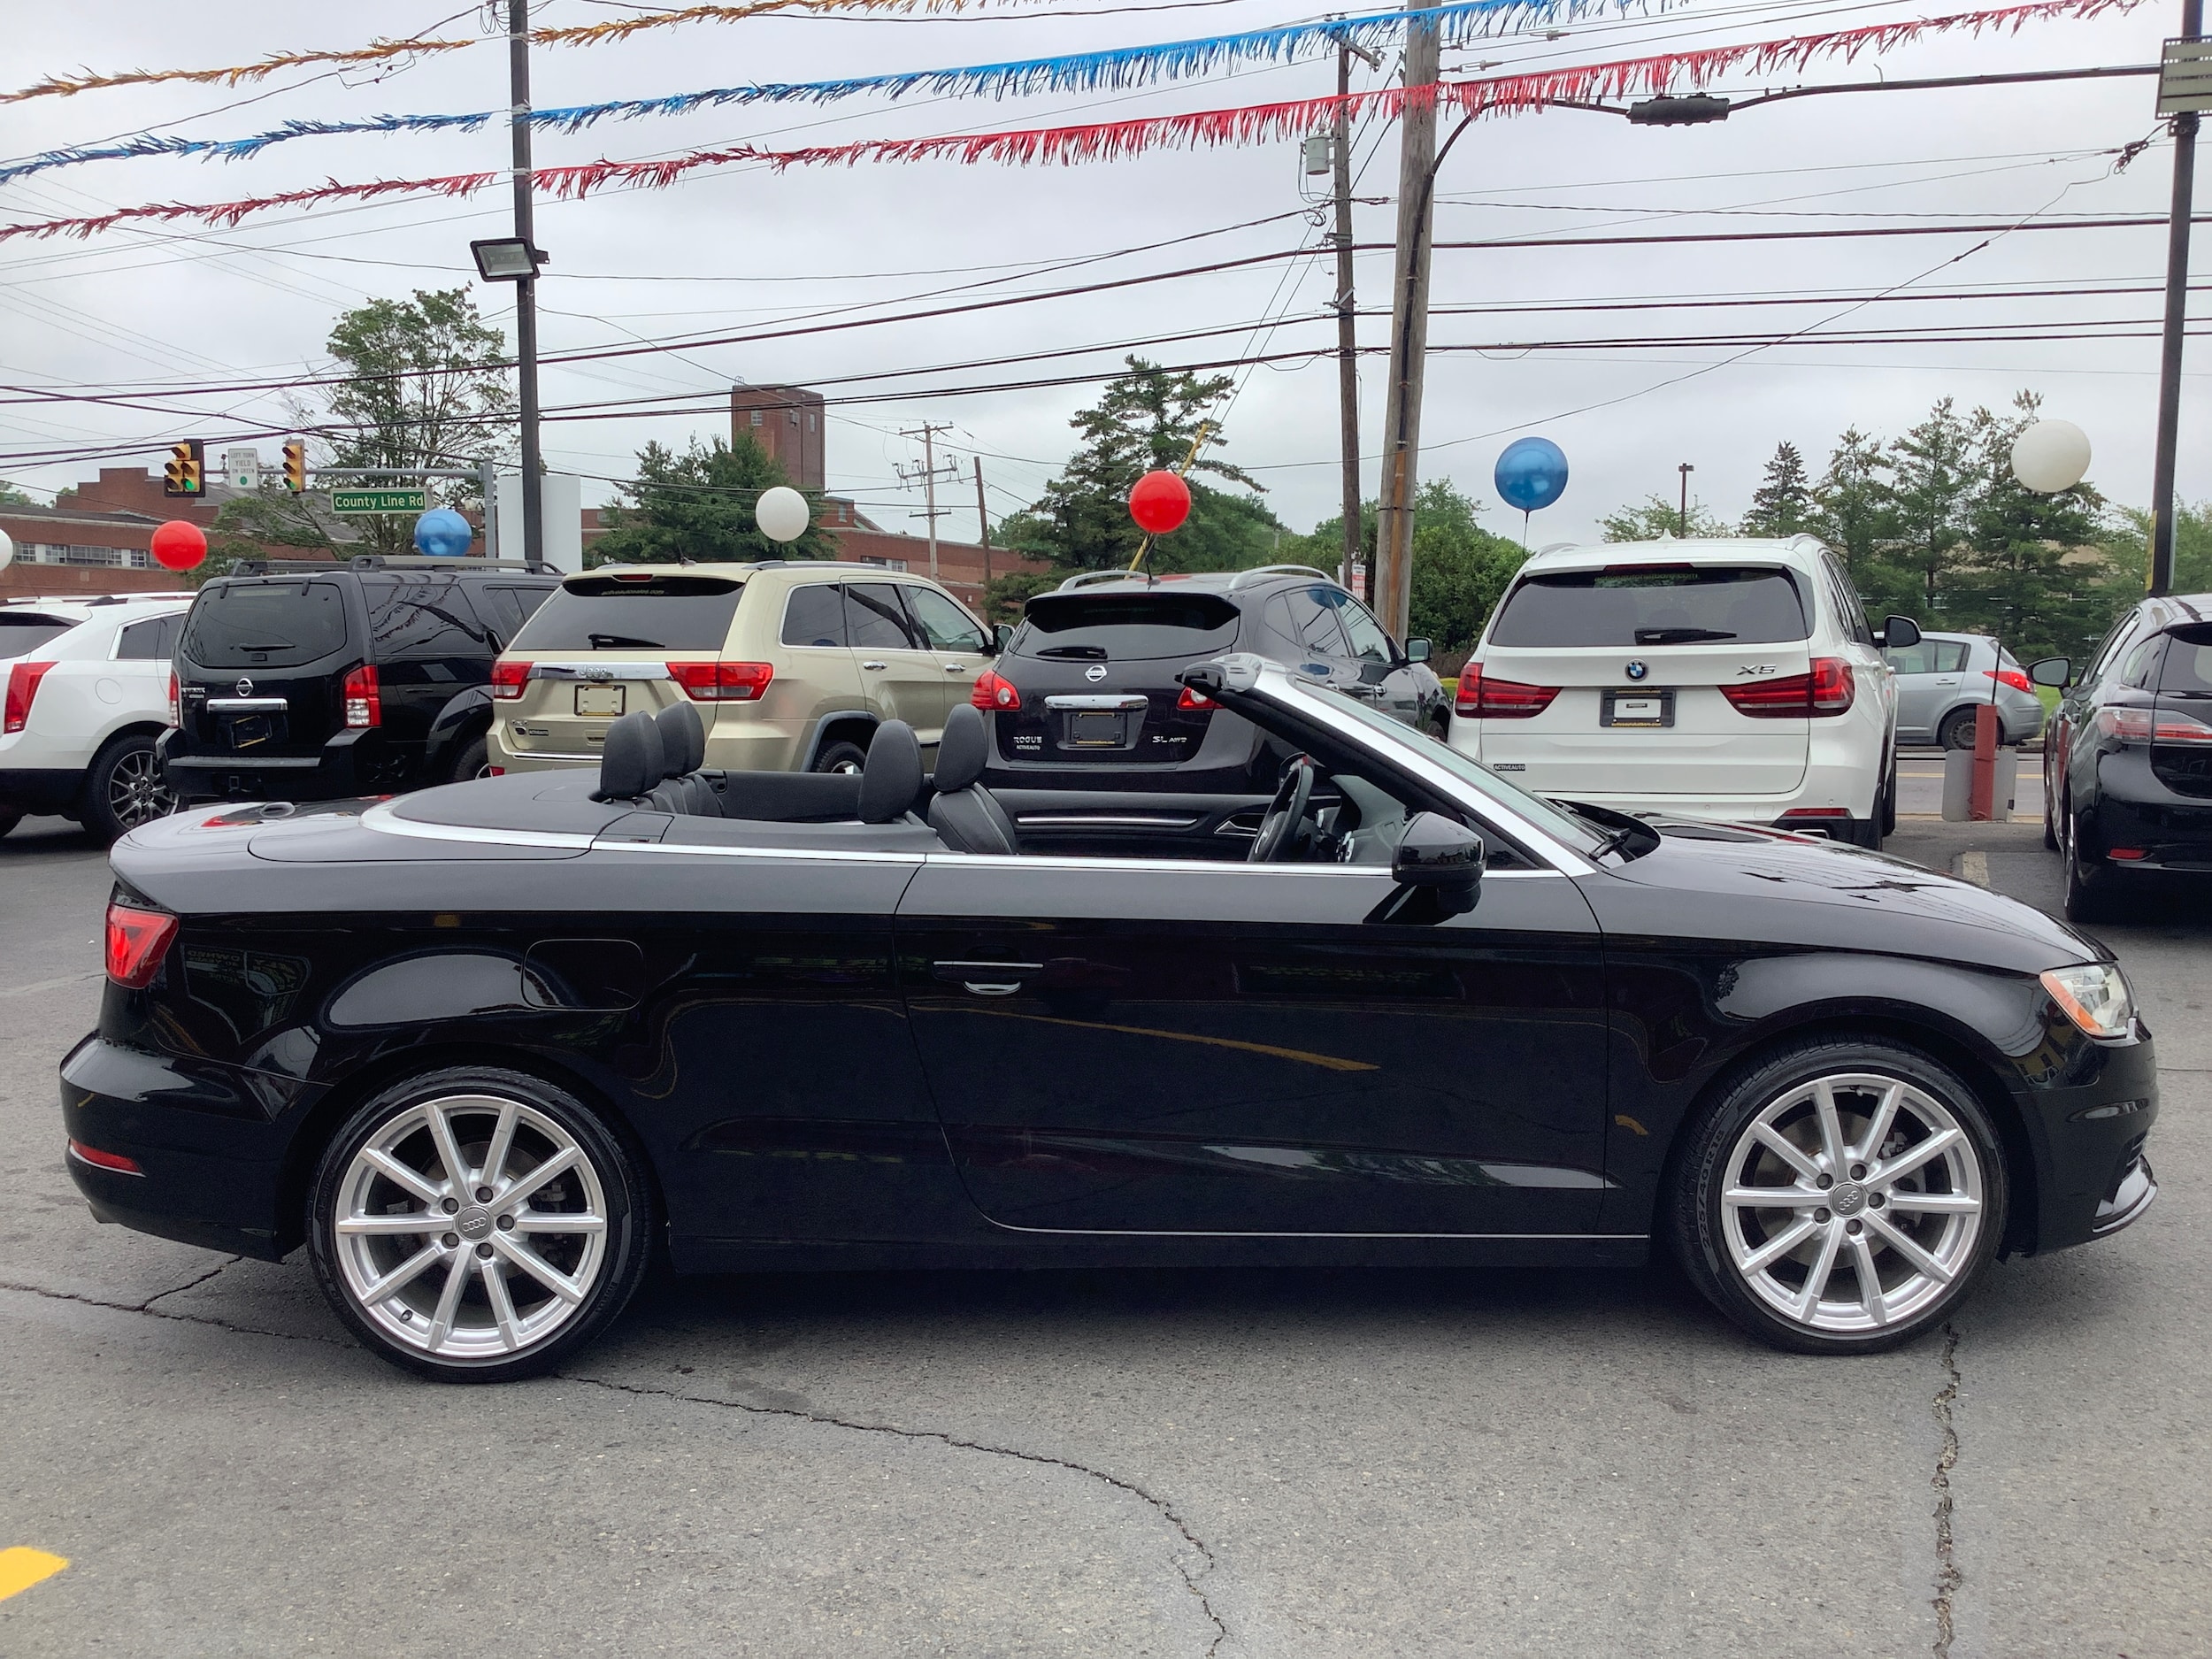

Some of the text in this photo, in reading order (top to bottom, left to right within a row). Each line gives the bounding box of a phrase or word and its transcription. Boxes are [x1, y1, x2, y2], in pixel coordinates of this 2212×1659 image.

[334, 495, 424, 510] County Line Rd
[1736, 664, 1778, 676] X5
[1013, 735, 1043, 744] ROGUE
